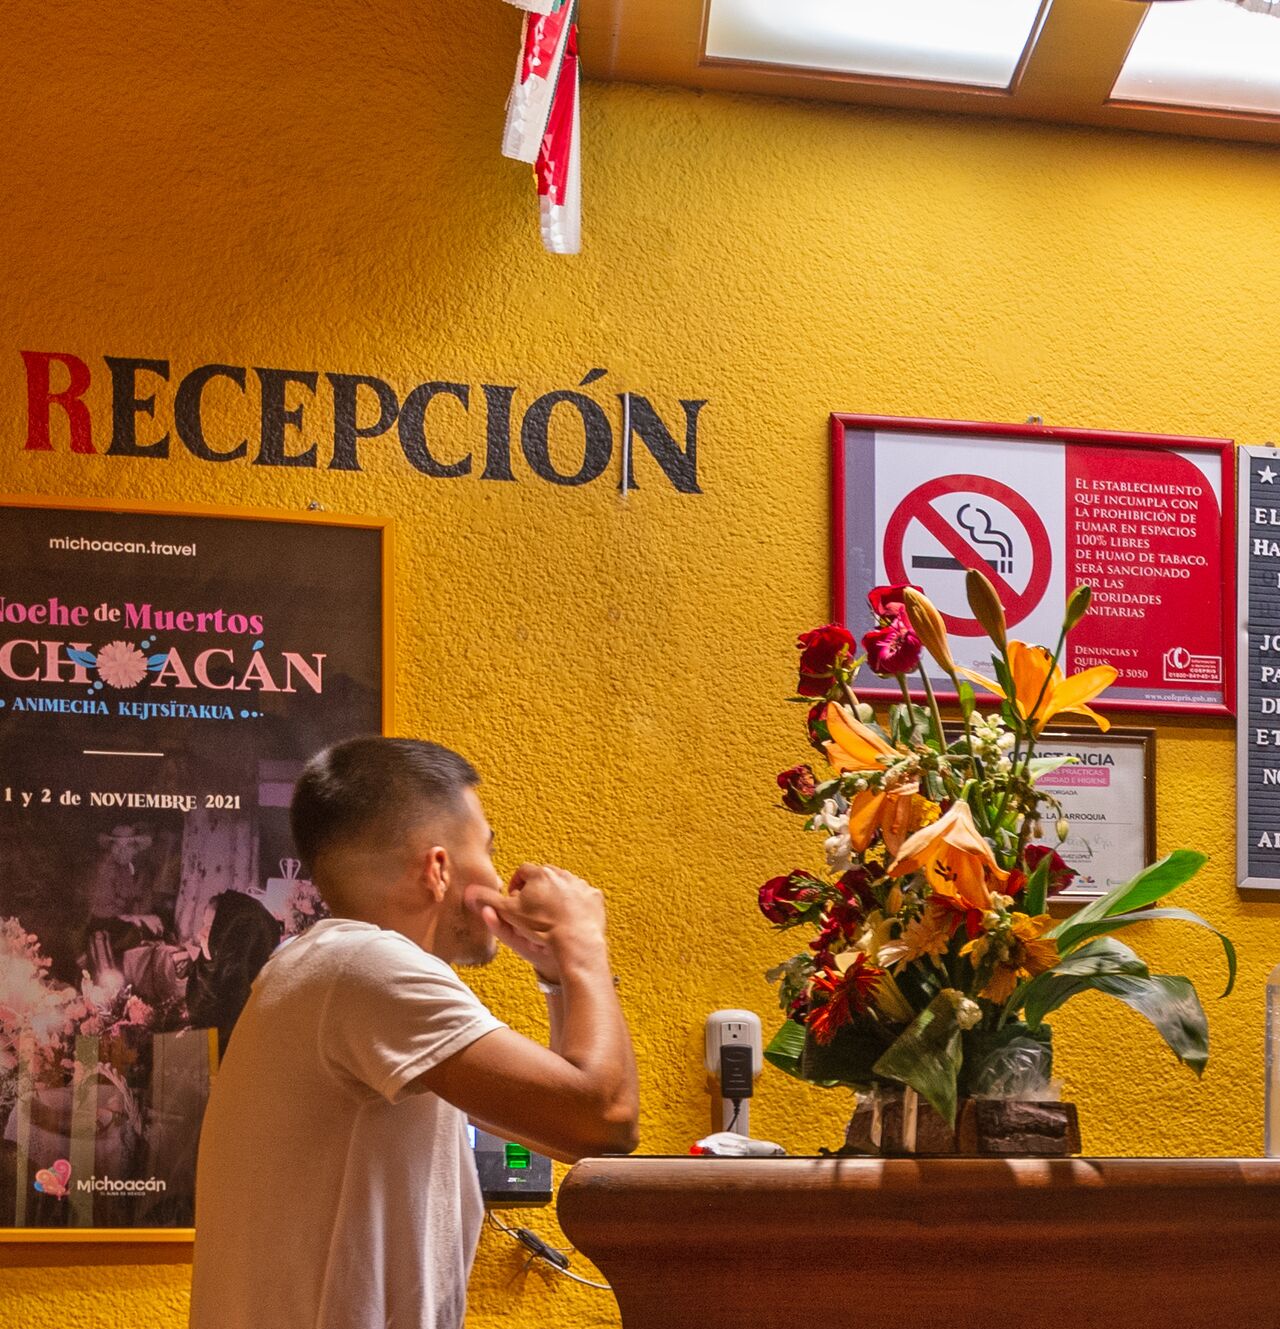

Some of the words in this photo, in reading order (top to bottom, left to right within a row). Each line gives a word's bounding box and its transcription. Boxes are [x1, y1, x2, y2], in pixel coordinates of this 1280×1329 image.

[20, 351, 707, 495] RECEPCIÓN
[1075, 478, 1089, 489] EL
[1093, 480, 1202, 496] ESTABLECIMIENTO
[1075, 493, 1100, 505] QUE
[1105, 496, 1168, 508] INCUMPLA
[1171, 500, 1198, 509] CON
[1076, 508, 1089, 517] LA
[1094, 509, 1176, 522] PROHIBICIÓN
[1180, 514, 1196, 523] DE
[1075, 522, 1117, 532] FUMAR
[1122, 524, 1136, 534] EN
[1142, 526, 1196, 537] ESPACIOS
[49, 538, 196, 556] michoacan.travel
[1076, 535, 1106, 546] 100%
[1111, 538, 1150, 548] LIBRES
[1076, 550, 1091, 559] DE
[1096, 551, 1135, 561] HUMO
[1140, 554, 1155, 563] DE
[1159, 554, 1208, 566] TABACO.
[1075, 563, 1104, 574] SERÁ
[1108, 565, 1190, 578] SANCIONADO
[1075, 578, 1100, 587] POR
[1104, 580, 1124, 588] LAS
[1091, 592, 1161, 604] TORIDADES
[0, 598, 88, 626] oche
[94, 603, 120, 622] de
[124, 604, 263, 635] Muertos
[1085, 607, 1145, 618] ANITARIAS
[1075, 646, 1130, 656] DENUNCIAS
[0, 640, 326, 693] CHACÁN
[1126, 670, 1148, 678] 5050
[12, 698, 109, 714] ANIMECHA
[22, 794, 33, 806] y
[41, 789, 51, 802] 2
[60, 790, 81, 806] de
[90, 792, 196, 811] NOVIEMBRE
[205, 795, 240, 809] 2021
[77, 1175, 166, 1193] Michoacán
